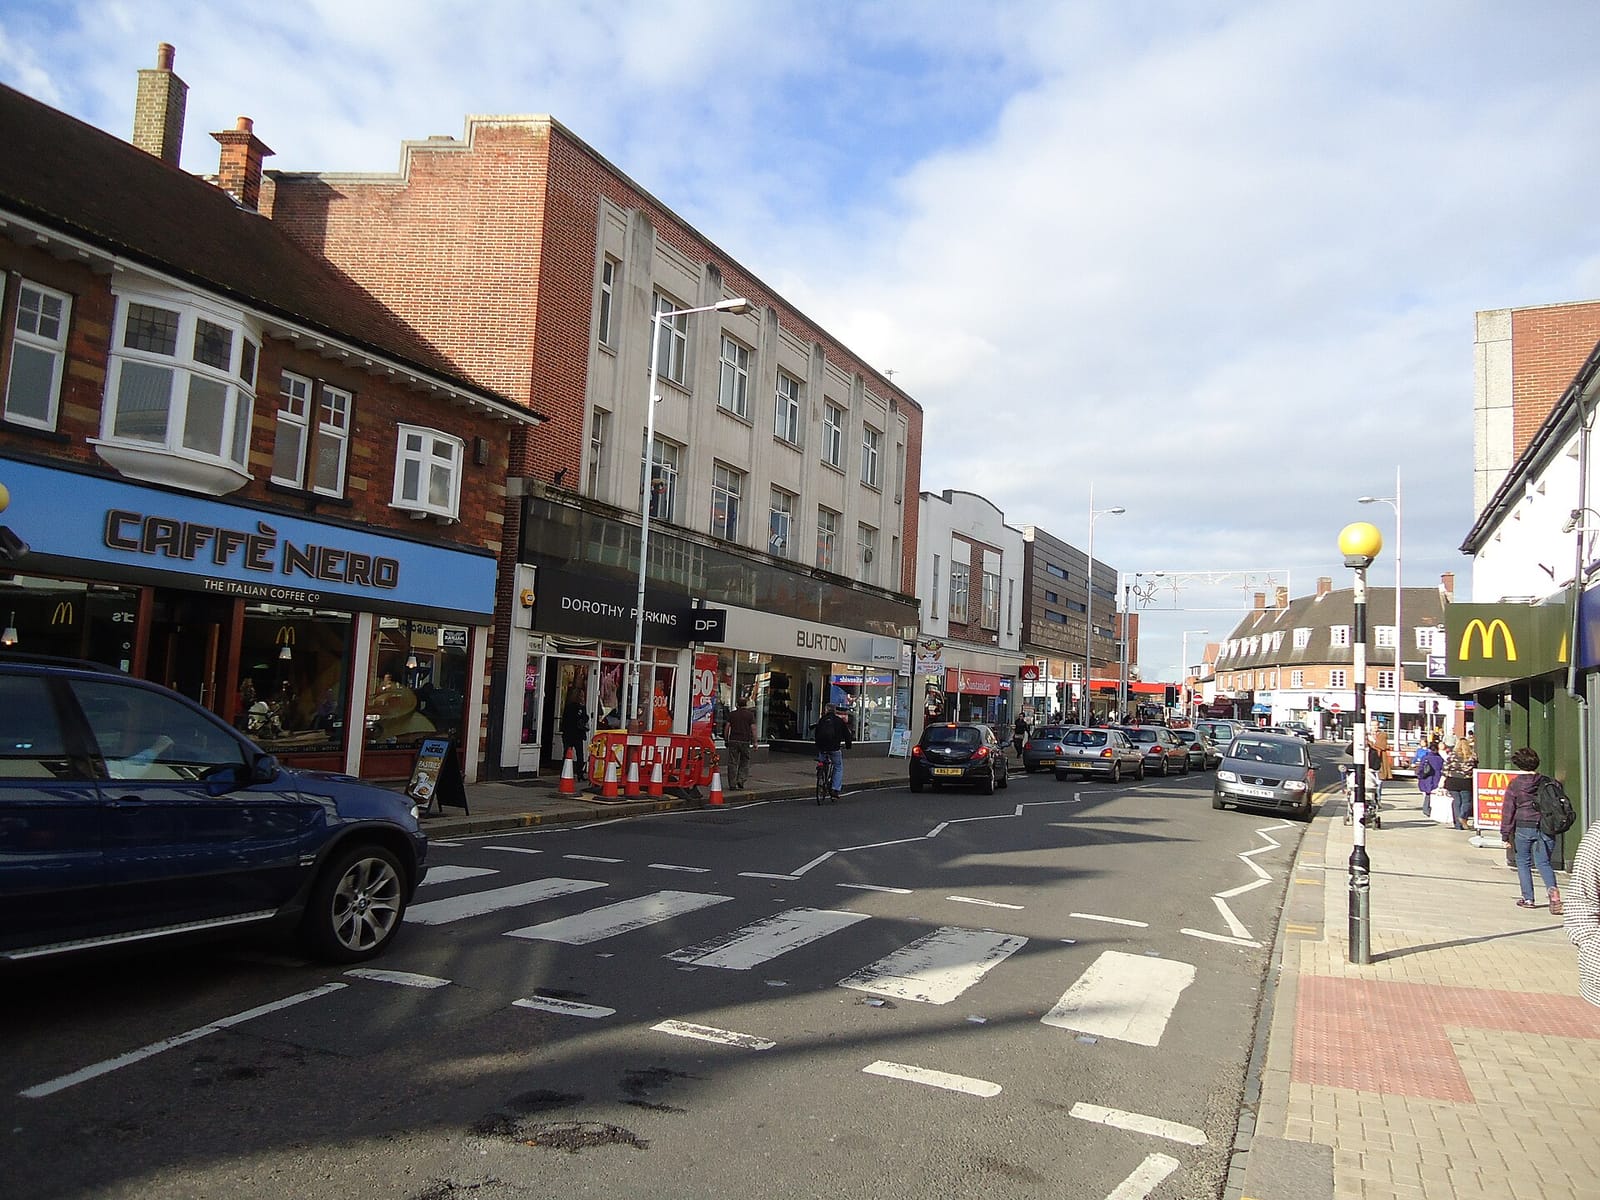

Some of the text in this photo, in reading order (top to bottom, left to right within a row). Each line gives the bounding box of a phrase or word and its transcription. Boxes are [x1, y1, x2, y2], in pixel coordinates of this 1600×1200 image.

[105, 509, 400, 589] CAFFÈ NERO
[204, 579, 224, 591] THE
[227, 581, 267, 597] ITALIAN
[270, 588, 305, 602] COFFEE
[561, 596, 677, 626] DOROTHY PRKINS
[695, 620, 718, 631] DP
[796, 630, 847, 653] BURTON
[966, 678, 991, 692] Santander
